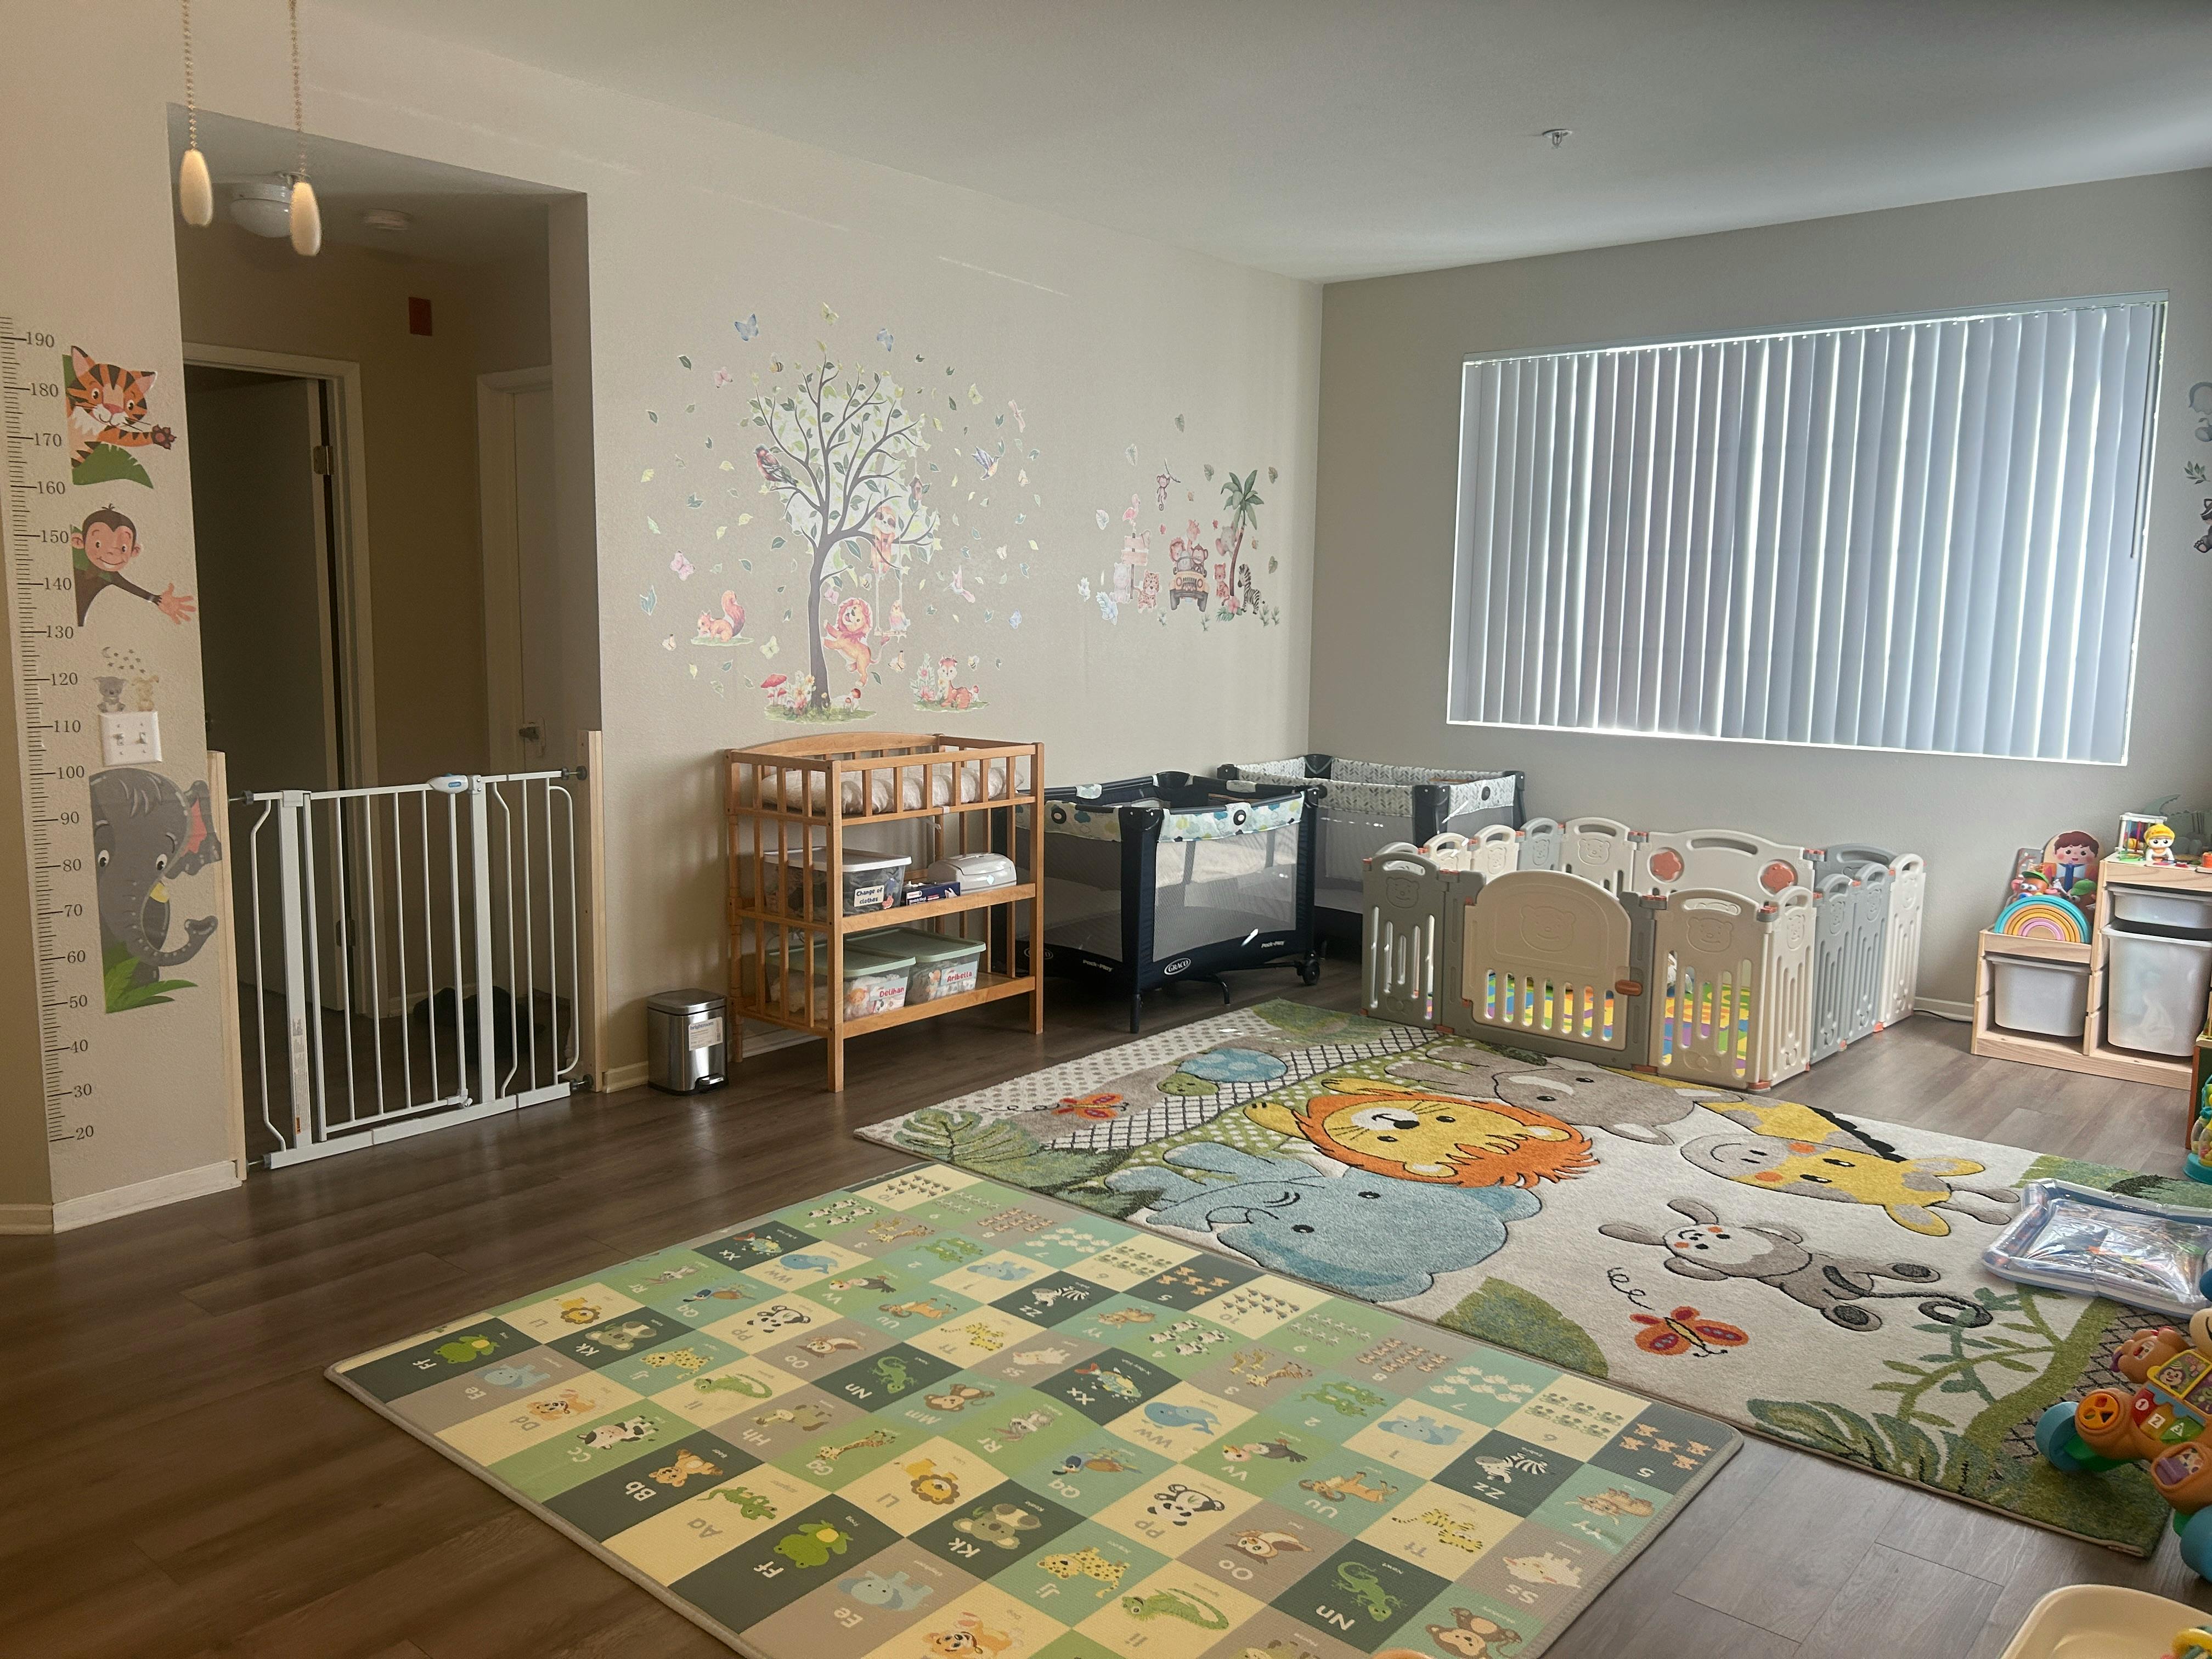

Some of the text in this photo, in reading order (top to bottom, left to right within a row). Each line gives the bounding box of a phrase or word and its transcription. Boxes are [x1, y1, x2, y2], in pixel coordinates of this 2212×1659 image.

[26, 333, 55, 348] 190
[30, 383, 59, 397] 180
[34, 433, 63, 447] 170
[37, 481, 66, 495] 160
[41, 530, 70, 544] 150
[44, 578, 72, 591] 140
[46, 625, 75, 640] 130
[50, 673, 78, 686] 120
[53, 720, 81, 733] 110
[57, 765, 84, 780] 100
[60, 812, 80, 825] 90
[63, 858, 82, 872] 80
[64, 904, 83, 917] 70
[67, 950, 86, 964] 60
[70, 995, 88, 1008] 50
[70, 1040, 89, 1053] 40
[74, 1083, 93, 1097] 30
[75, 1125, 94, 1139] 20
[719, 1250, 741, 1260] Xx
[764, 1270, 792, 1283] Ww
[628, 1284, 647, 1293] Rr
[822, 1293, 842, 1304] Vv
[676, 1304, 698, 1317] Qq
[1019, 1305, 1042, 1317] Zz
[876, 1316, 899, 1328] Uu
[1219, 1313, 1239, 1324] 10
[731, 1329, 753, 1341] Pp
[575, 1343, 599, 1356] Kk
[938, 1344, 957, 1354] Tt
[412, 1358, 437, 1369] Ff
[785, 1355, 809, 1368] Oo
[630, 1370, 649, 1379] Jj
[1372, 1373, 1387, 1381] 8
[465, 1387, 486, 1400] Ee
[845, 1384, 872, 1398] Nn
[1066, 1387, 1095, 1405] Xx
[1224, 1386, 1239, 1395] 3
[509, 1416, 540, 1431] Dd
[905, 1410, 941, 1424] Mm
[1304, 1417, 1321, 1426] 2
[2152, 1417, 2161, 1425] 2
[2175, 1424, 2183, 1432] 3
[743, 1429, 771, 1446] Hh
[977, 1437, 1002, 1452] Rr
[1133, 1429, 1172, 1448] Ww
[567, 1447, 591, 1462] Cc
[1221, 1465, 1247, 1480] Vv
[1637, 1468, 1655, 1477] 5
[625, 1481, 656, 1500] Bb
[1048, 1478, 1080, 1498] Qq
[1472, 1482, 1505, 1499] Zz
[1305, 1499, 1338, 1517] Uu
[687, 1518, 723, 1538] Aa
[1135, 1520, 1165, 1538] Pp
[948, 1538, 980, 1558] Kk
[1404, 1542, 1426, 1558] Tt
[753, 1561, 784, 1578] Ff
[1218, 1560, 1253, 1580] Oo
[1036, 1583, 1060, 1598] Jj
[1506, 1584, 1538, 1603] Ss
[834, 1607, 862, 1627] Ee
[1316, 1605, 1355, 1630] Nn
